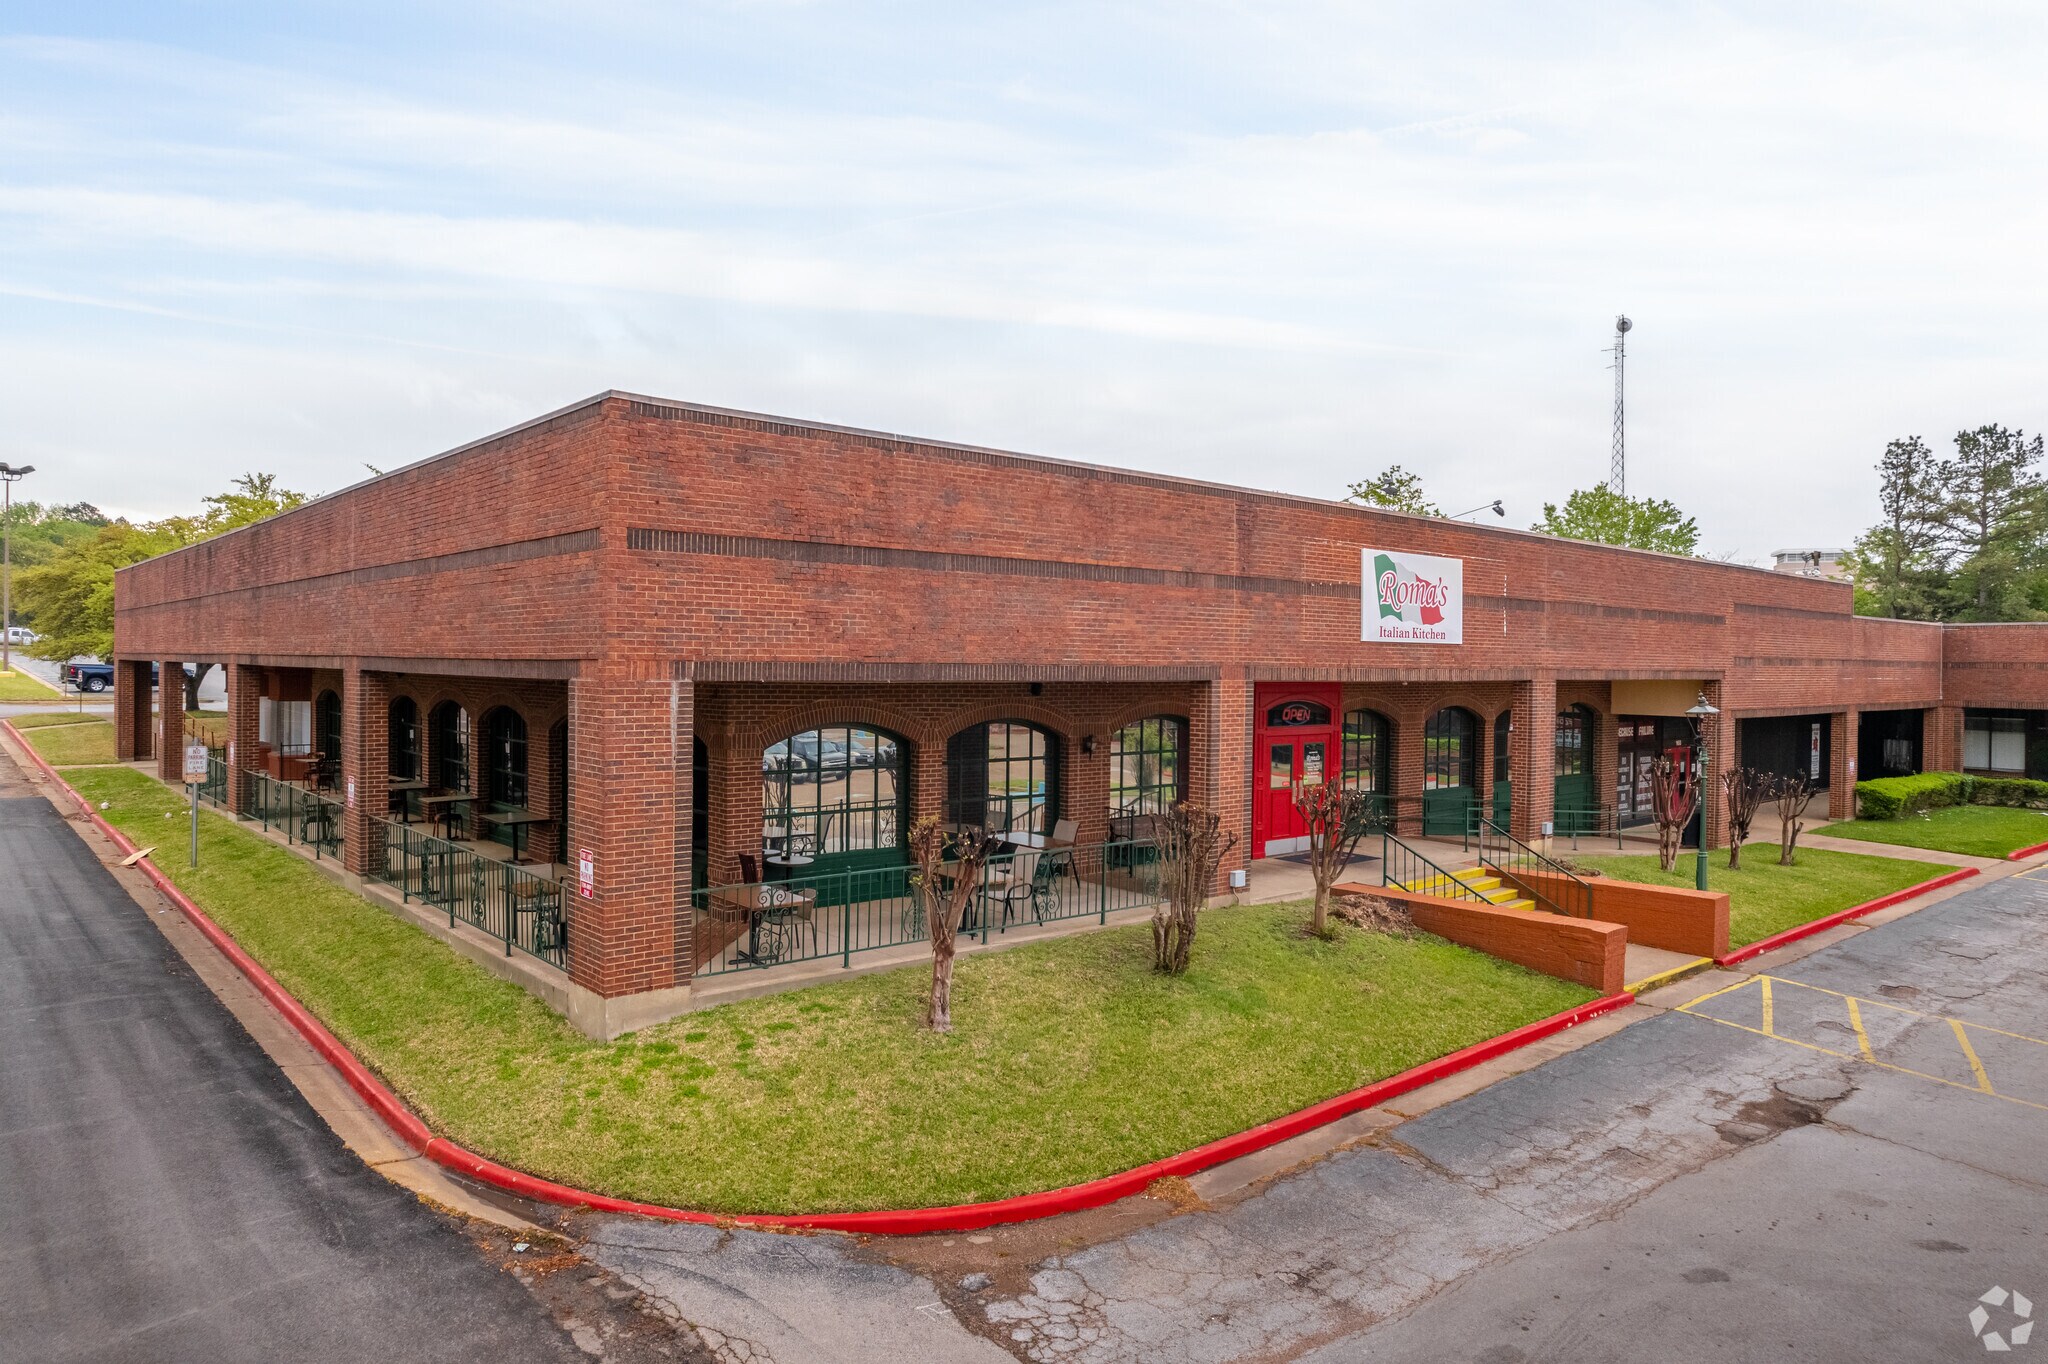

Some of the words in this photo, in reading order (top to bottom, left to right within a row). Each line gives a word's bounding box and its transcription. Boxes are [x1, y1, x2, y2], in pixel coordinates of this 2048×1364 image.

[1380, 571, 1448, 611] Roma's
[1379, 626, 1410, 639] Italian
[1412, 628, 1446, 640] Kitchen
[1282, 708, 1311, 721] OPEN
